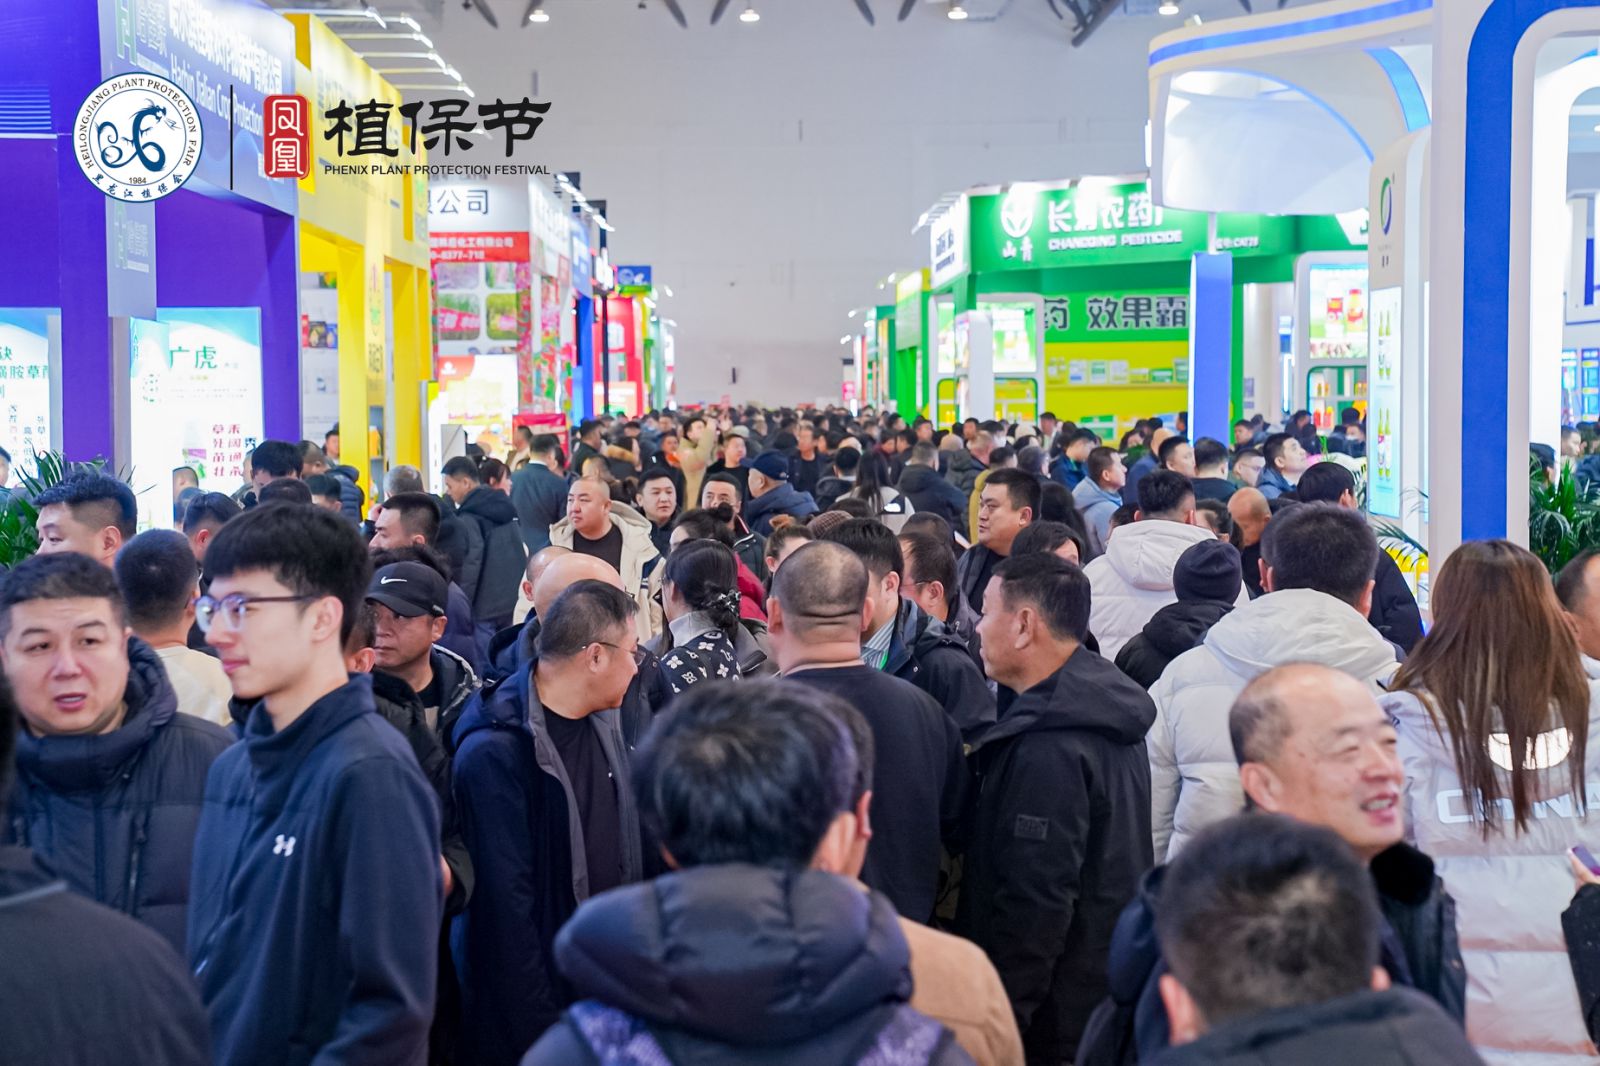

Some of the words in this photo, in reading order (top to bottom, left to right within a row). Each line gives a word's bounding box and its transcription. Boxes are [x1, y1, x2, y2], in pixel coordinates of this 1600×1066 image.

[1121, 230, 1182, 245] PESTICIDE
[1088, 296, 1187, 329] 效果霸
[169, 346, 217, 369] 广虎
